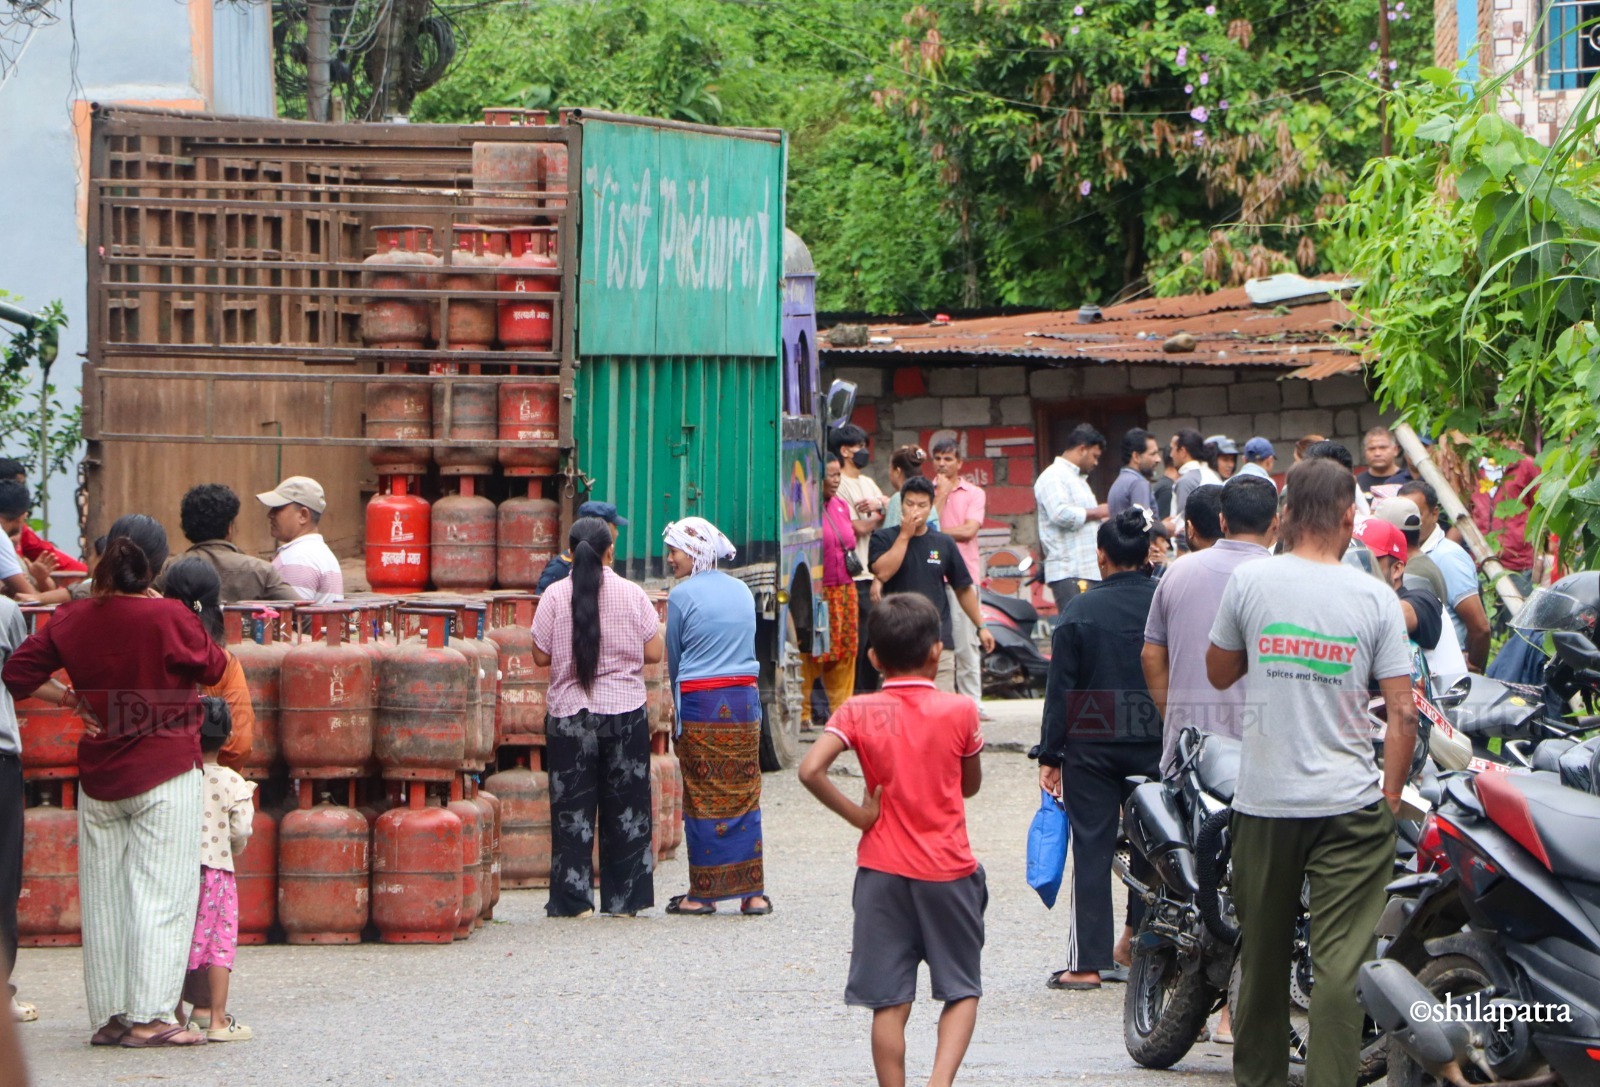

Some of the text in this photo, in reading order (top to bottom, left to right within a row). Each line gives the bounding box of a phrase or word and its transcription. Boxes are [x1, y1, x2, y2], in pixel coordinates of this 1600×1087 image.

[585, 162, 652, 291] Visit
[1258, 636, 1357, 664] CENTURY
[1266, 668, 1343, 686] Spices and Snacks
